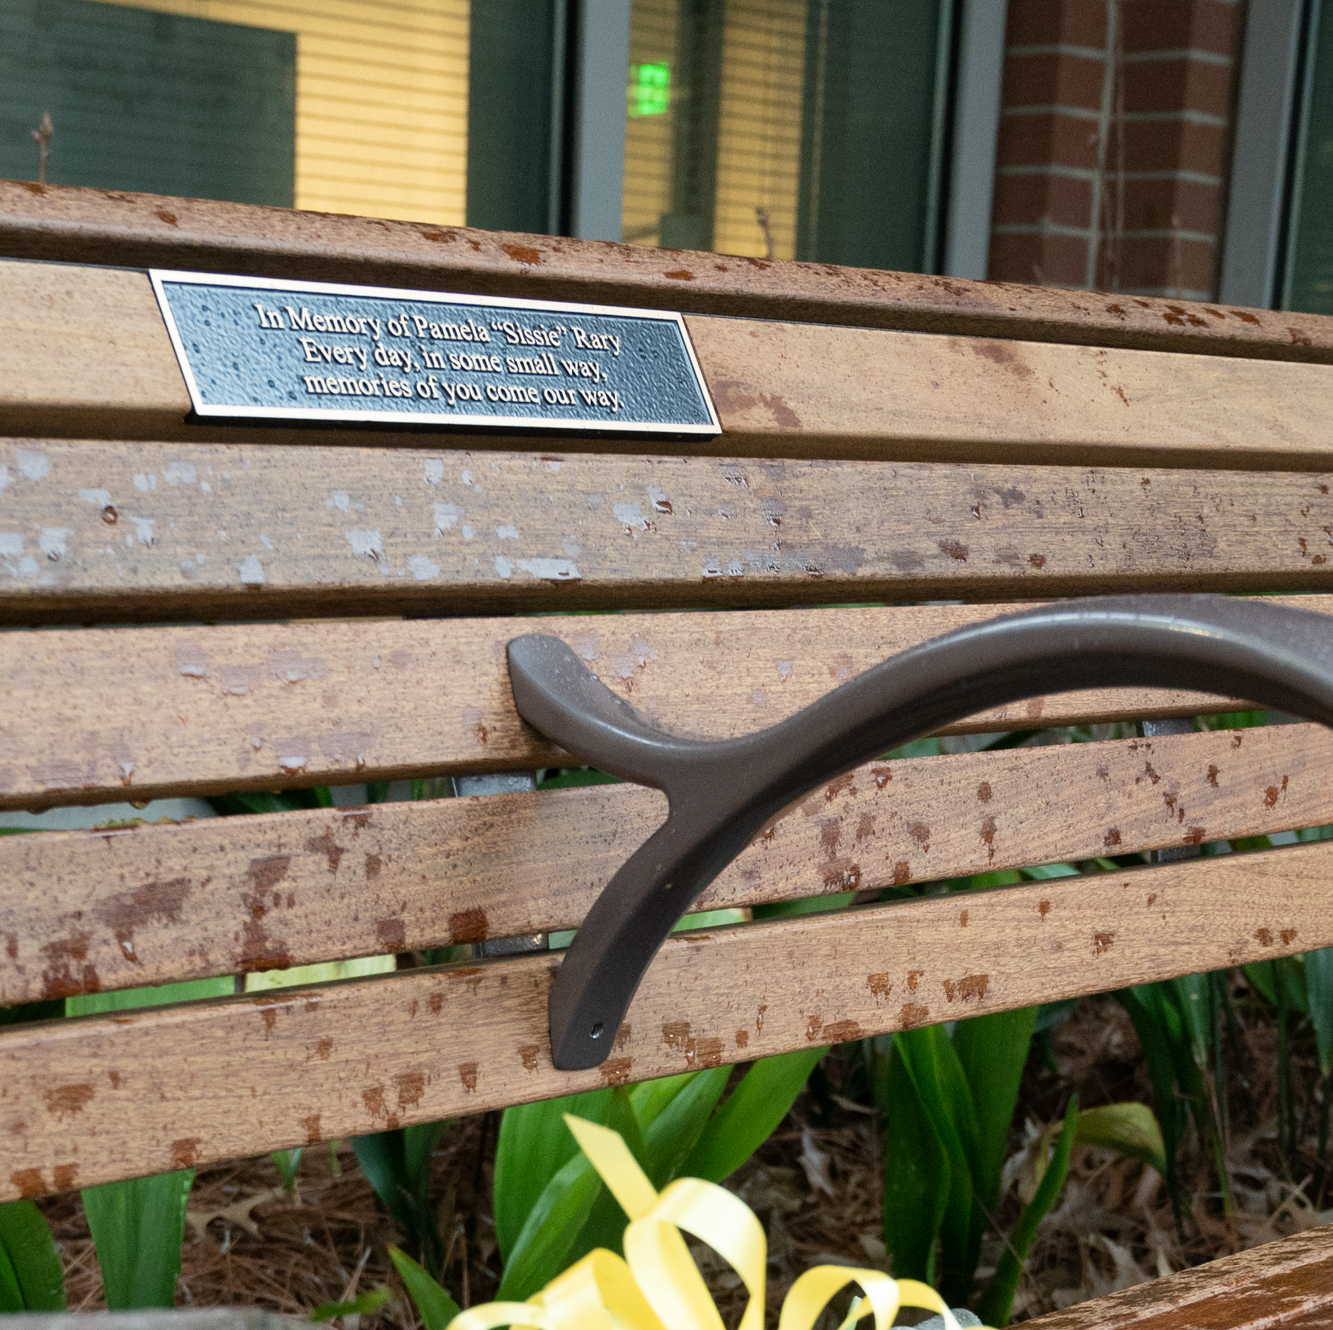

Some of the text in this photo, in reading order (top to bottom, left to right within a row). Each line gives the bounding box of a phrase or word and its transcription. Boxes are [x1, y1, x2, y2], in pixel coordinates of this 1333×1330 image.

[254, 304, 621, 355] In Memory of Pamela “Sissie” Rary
[299, 337, 608, 383] Every day, in some small way,
[303, 373, 625, 413] memories of you come our way.
